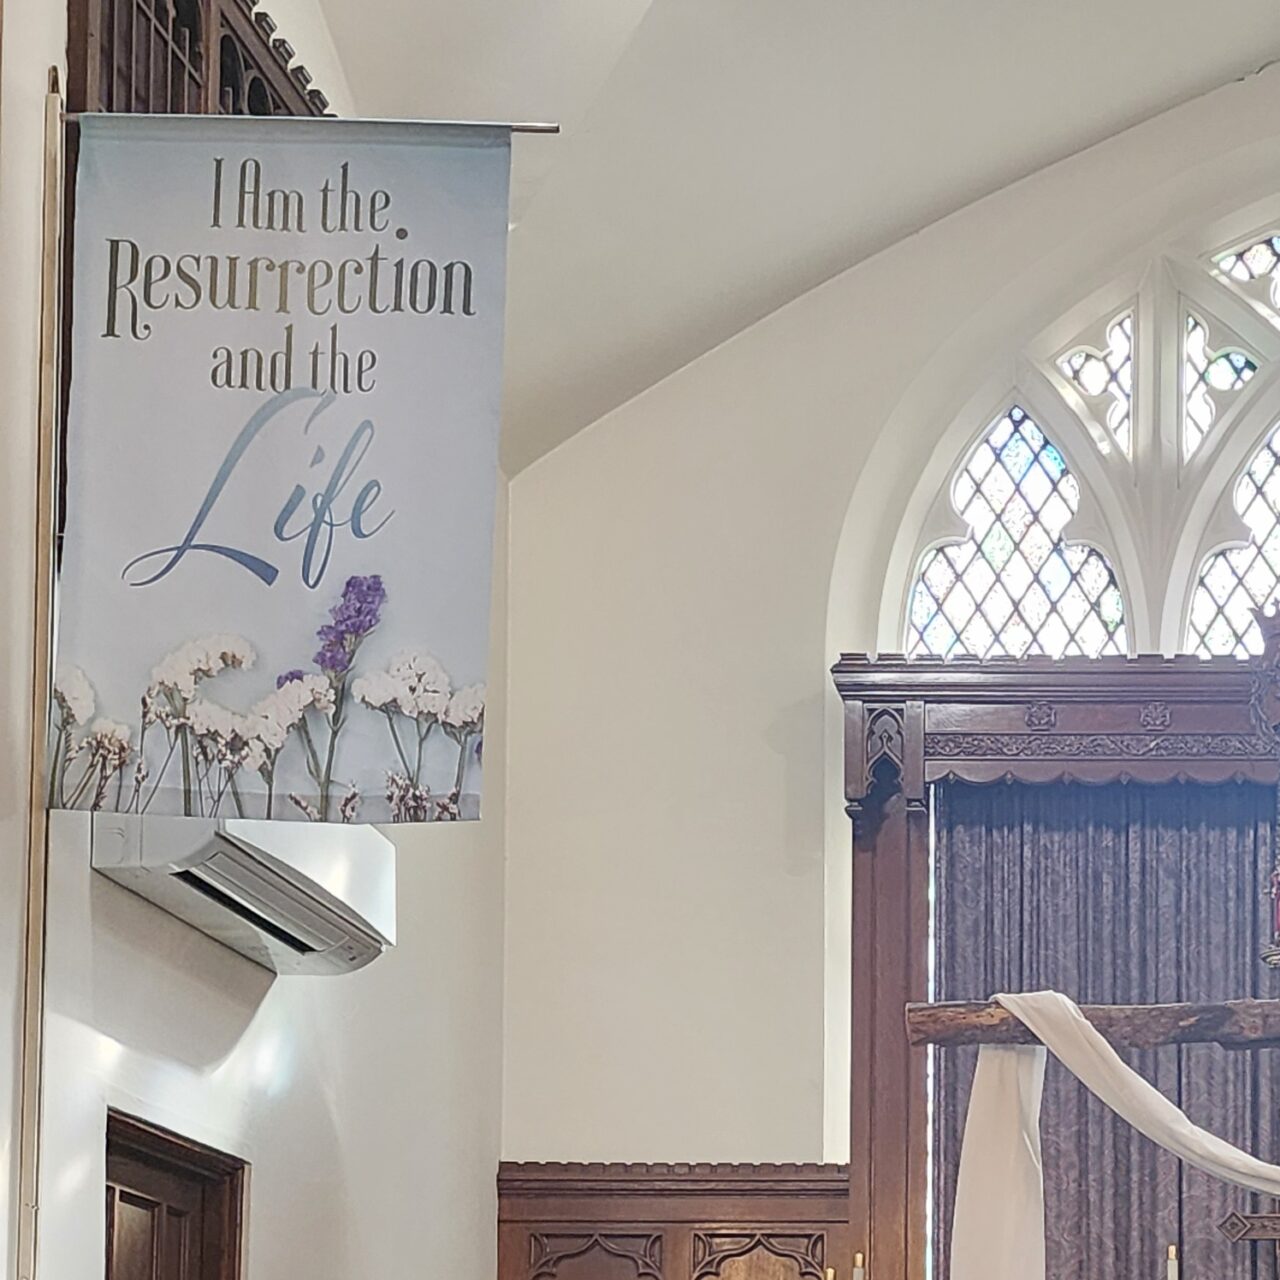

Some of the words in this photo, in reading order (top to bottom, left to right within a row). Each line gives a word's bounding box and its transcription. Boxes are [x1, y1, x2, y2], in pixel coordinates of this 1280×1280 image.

[210, 157, 226, 230] I
[236, 158, 307, 233] Am
[320, 161, 391, 234] the
[100, 227, 477, 341] Resurrection
[210, 323, 294, 393] and
[308, 323, 378, 396] the
[121, 386, 396, 590] Life
